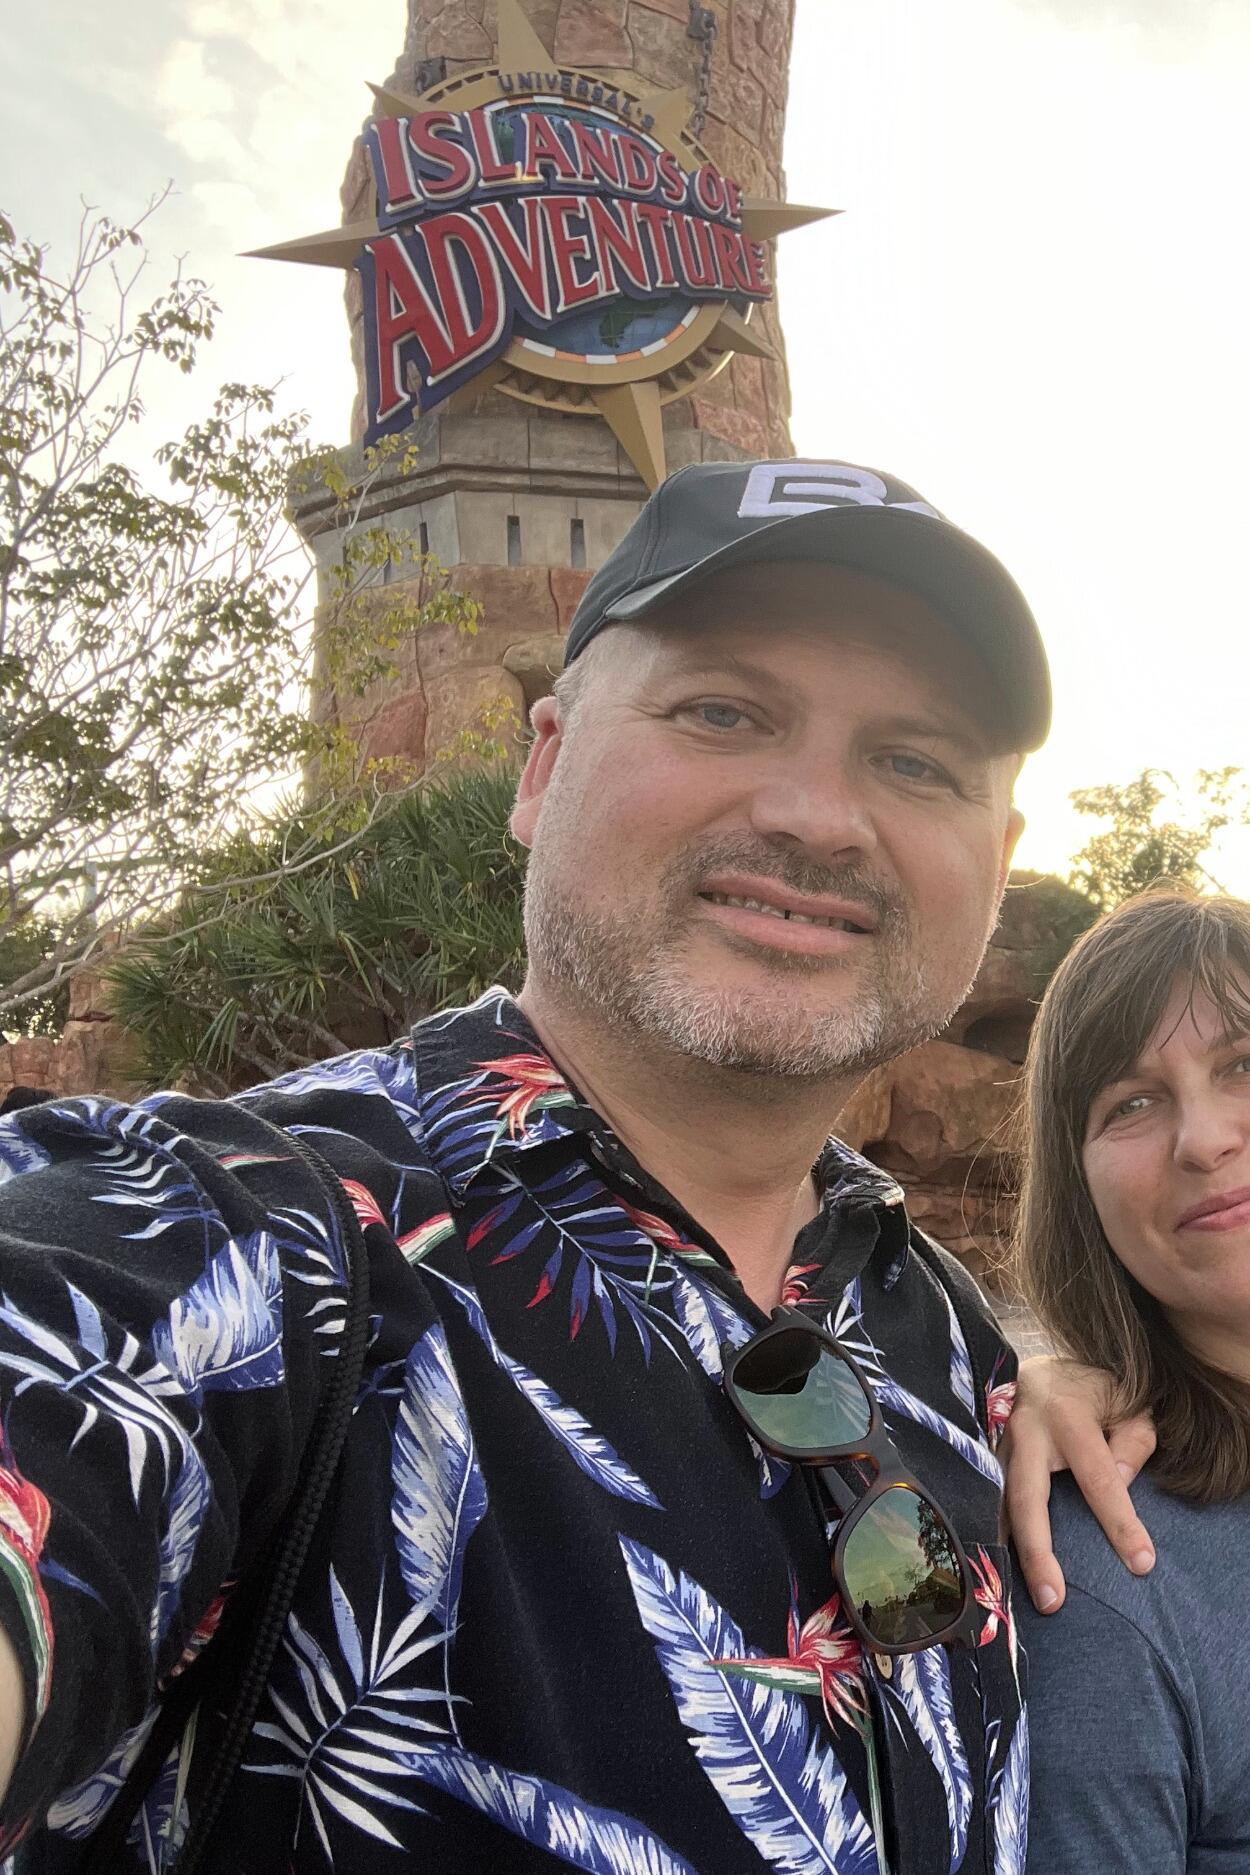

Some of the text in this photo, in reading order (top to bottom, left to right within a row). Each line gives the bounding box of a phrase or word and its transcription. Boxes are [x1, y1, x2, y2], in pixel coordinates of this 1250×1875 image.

[370, 110, 742, 225] ISLANDS OF
[367, 196, 773, 423] ADVENTURE
